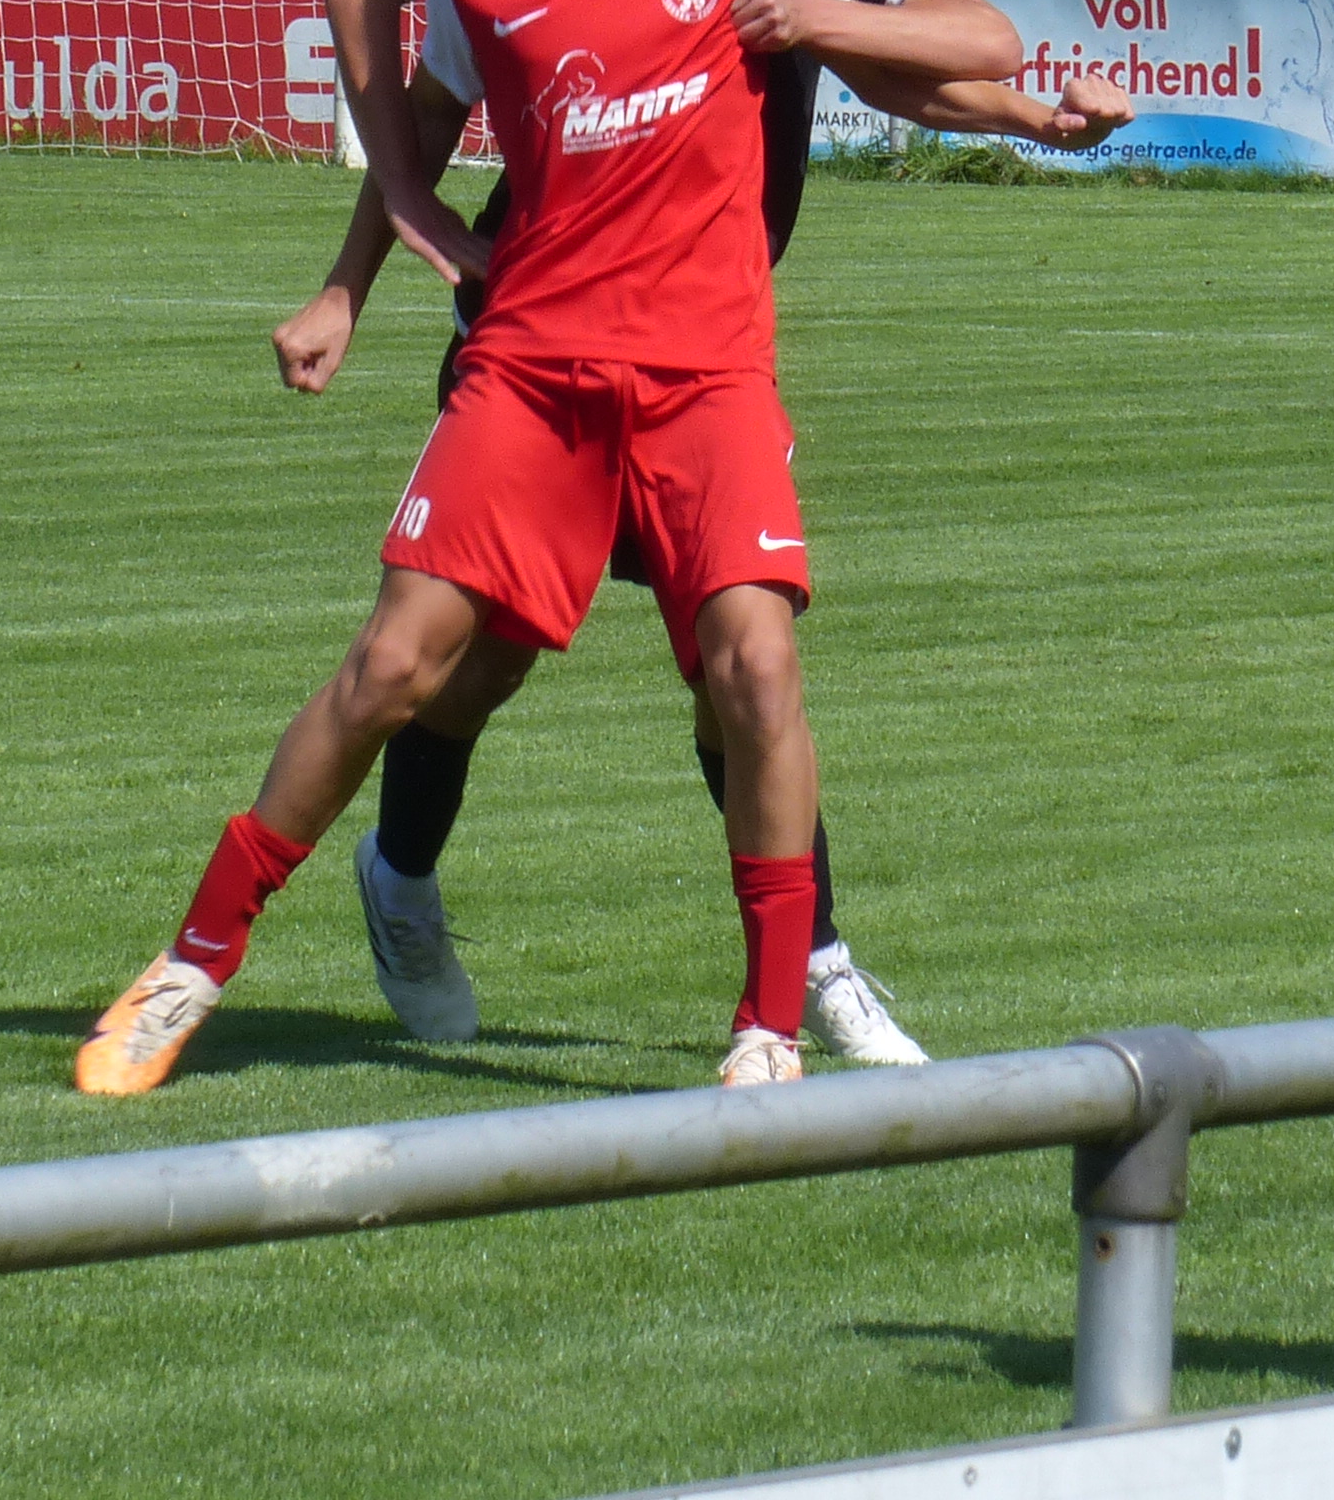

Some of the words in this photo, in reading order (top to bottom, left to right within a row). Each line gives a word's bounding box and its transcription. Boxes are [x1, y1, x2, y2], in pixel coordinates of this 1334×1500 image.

[1004, 27, 1261, 98] rfrischend!
[816, 111, 870, 129] MARKT
[397, 495, 430, 541] 10
